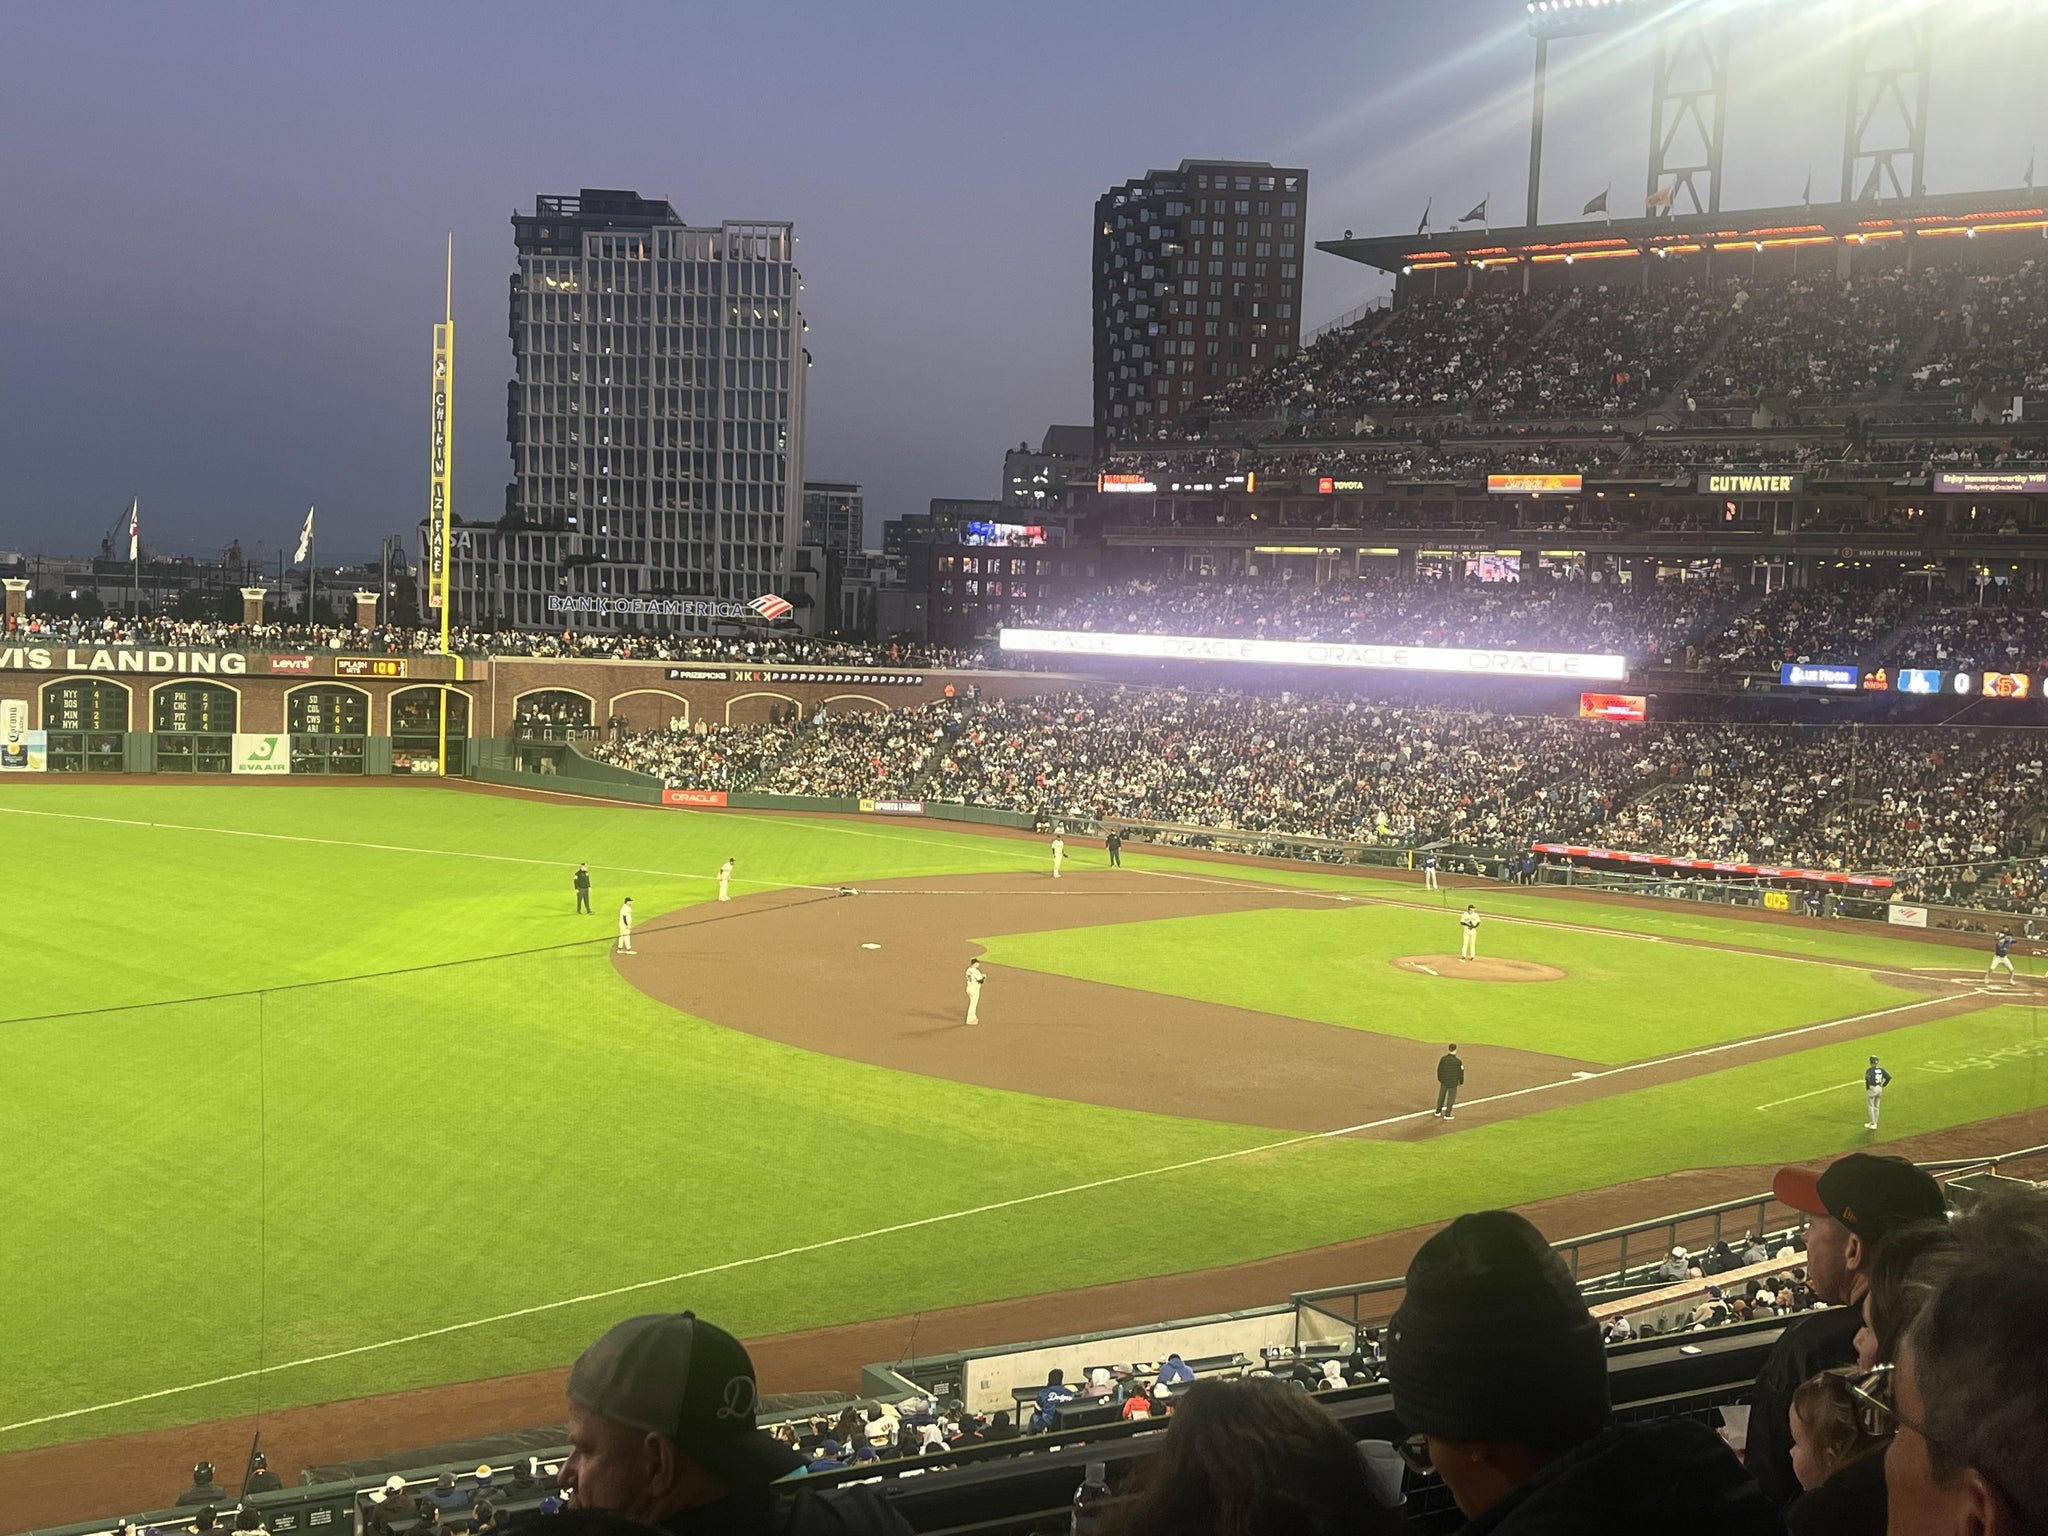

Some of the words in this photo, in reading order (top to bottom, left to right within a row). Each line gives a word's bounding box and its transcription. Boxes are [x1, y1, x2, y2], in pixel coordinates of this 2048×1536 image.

[435, 393, 445, 473] CHIKIN
[1505, 476, 1543, 490] Surfside
[1709, 475, 1793, 492] CUTWATER
[1943, 474, 1964, 484] Enjoy
[1964, 474, 2028, 484] homerun-worthy
[1333, 481, 1364, 490] TOYOTA
[432, 520, 443, 572] FARE
[548, 595, 608, 613] BANK
[614, 597, 641, 613] OF
[646, 599, 744, 618] AMERICA
[1029, 633, 1113, 651] ORACLE
[1162, 639, 1254, 658] ORACLE
[1308, 645, 1409, 666] ORACLE
[67, 649, 247, 674] LANDING
[339, 661, 368, 669] SPLASH
[1468, 652, 1581, 674] ORACLE
[680, 671, 727, 680] PRIZEPICKS
[1876, 668, 1887, 681] 6
[1954, 672, 1970, 694] 0
[63, 690, 78, 699] NYY
[174, 692, 186, 701] PHI
[64, 699, 78, 709] BOS
[173, 702, 187, 711] CHC
[307, 704, 320, 714] COL
[64, 711, 78, 719] MIN
[174, 713, 185, 722] PIT
[306, 715, 321, 724] CWS
[8, 707, 20, 743] Corona
[62, 720, 78, 729] NYM
[173, 722, 187, 731] TEX
[307, 724, 319, 733] ARI
[411, 760, 439, 772] 309
[671, 792, 719, 804] ORACLE
[1048, 1392, 1073, 1402] Dodgers
